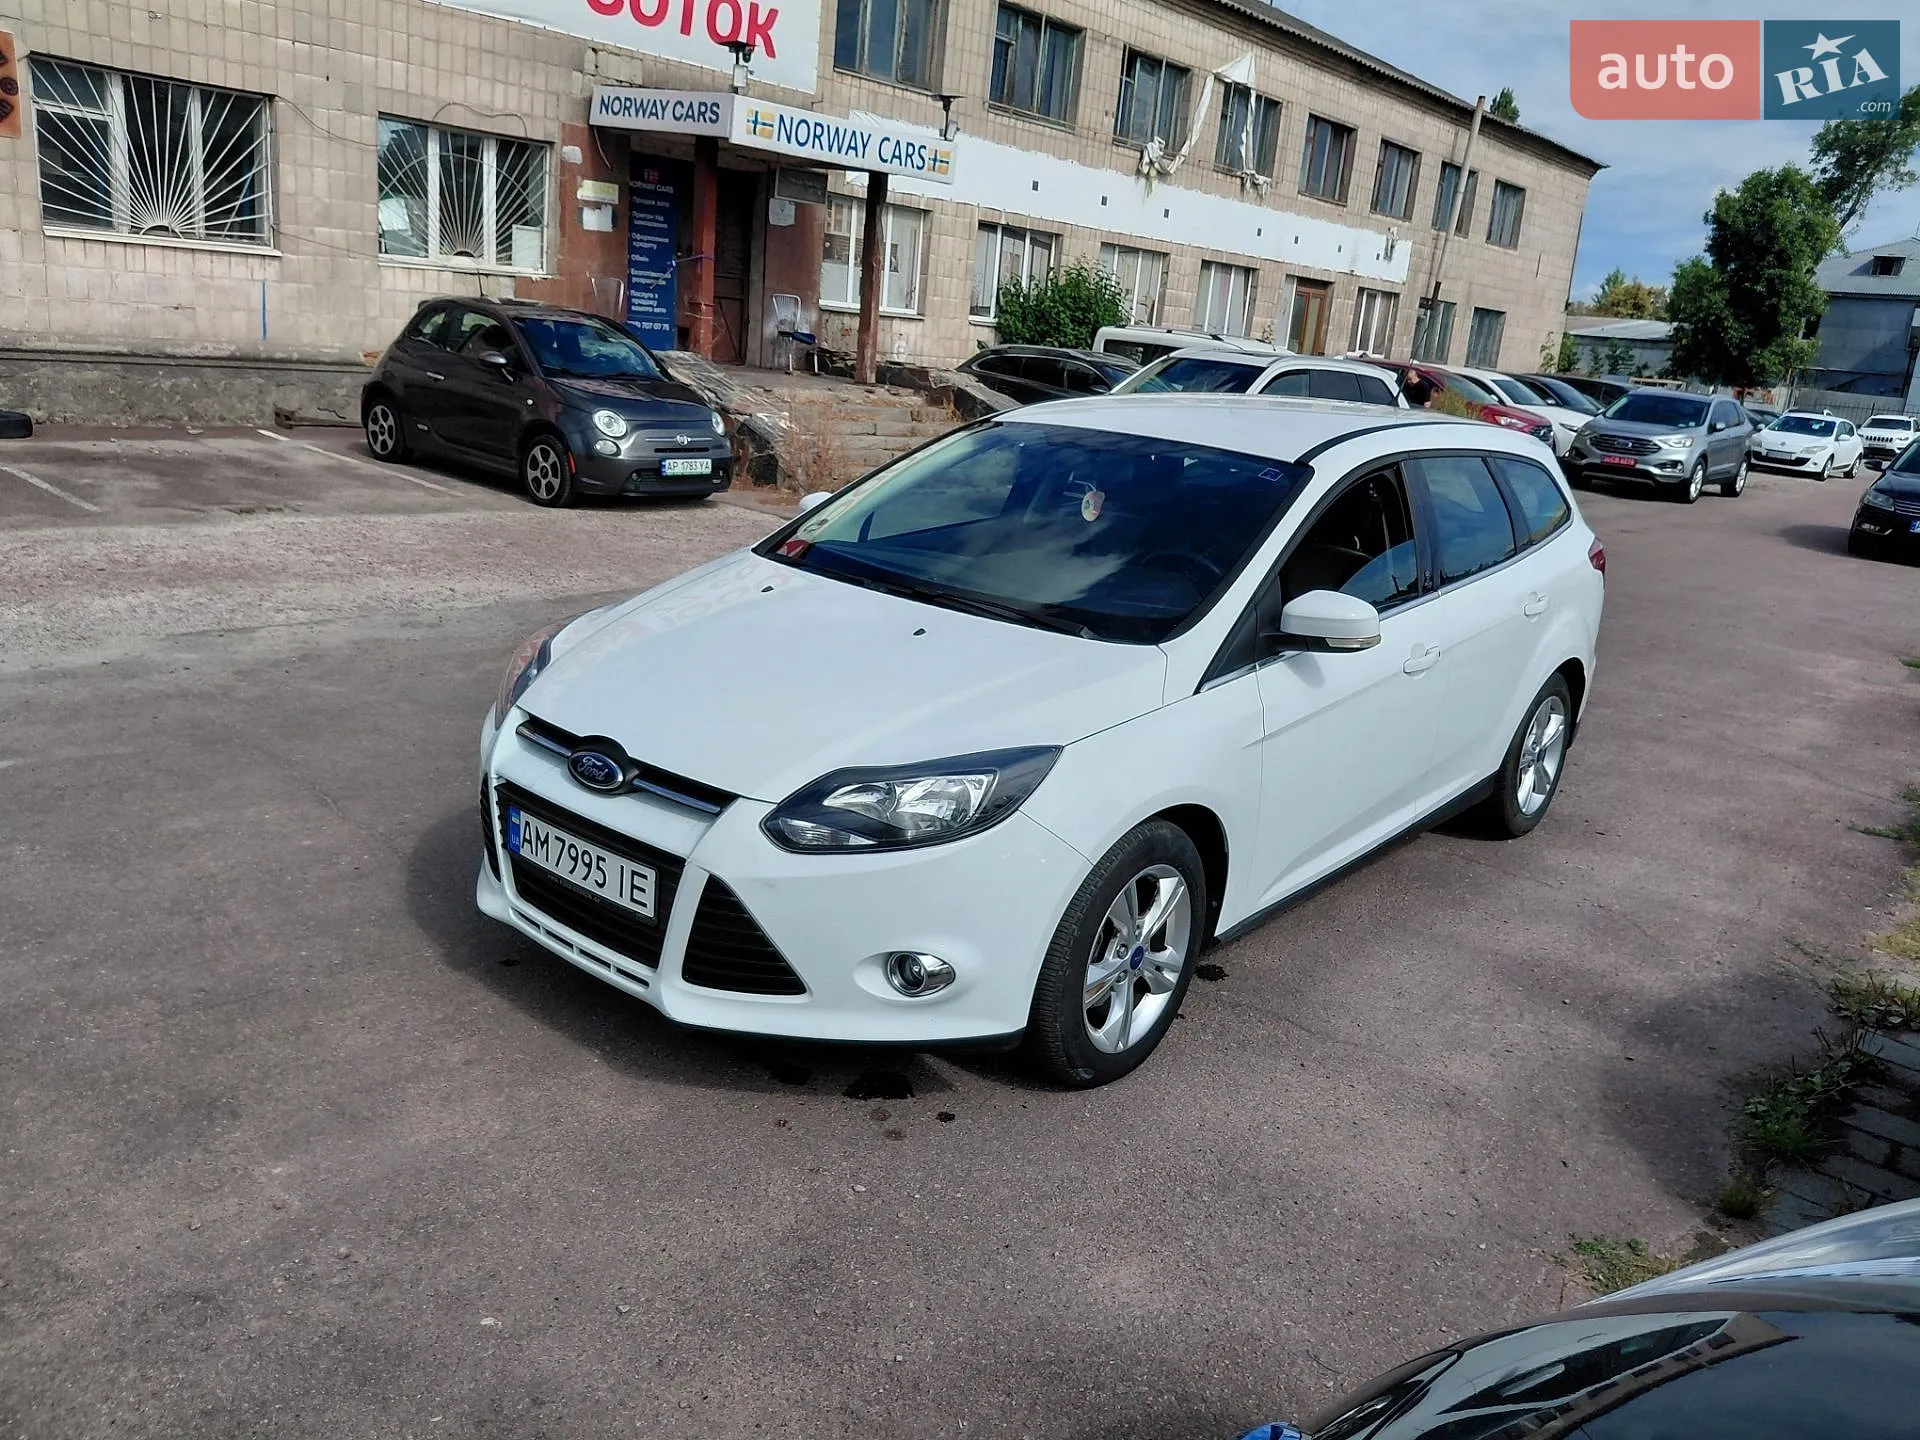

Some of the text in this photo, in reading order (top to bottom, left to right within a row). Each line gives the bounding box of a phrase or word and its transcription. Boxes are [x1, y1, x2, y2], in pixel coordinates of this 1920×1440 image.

[599, 94, 720, 125] NORWAY CARS
[776, 113, 927, 172] NORWAY CARS
[667, 461, 679, 472] AP
[577, 756, 609, 781] Ford
[619, 864, 650, 909] IE
